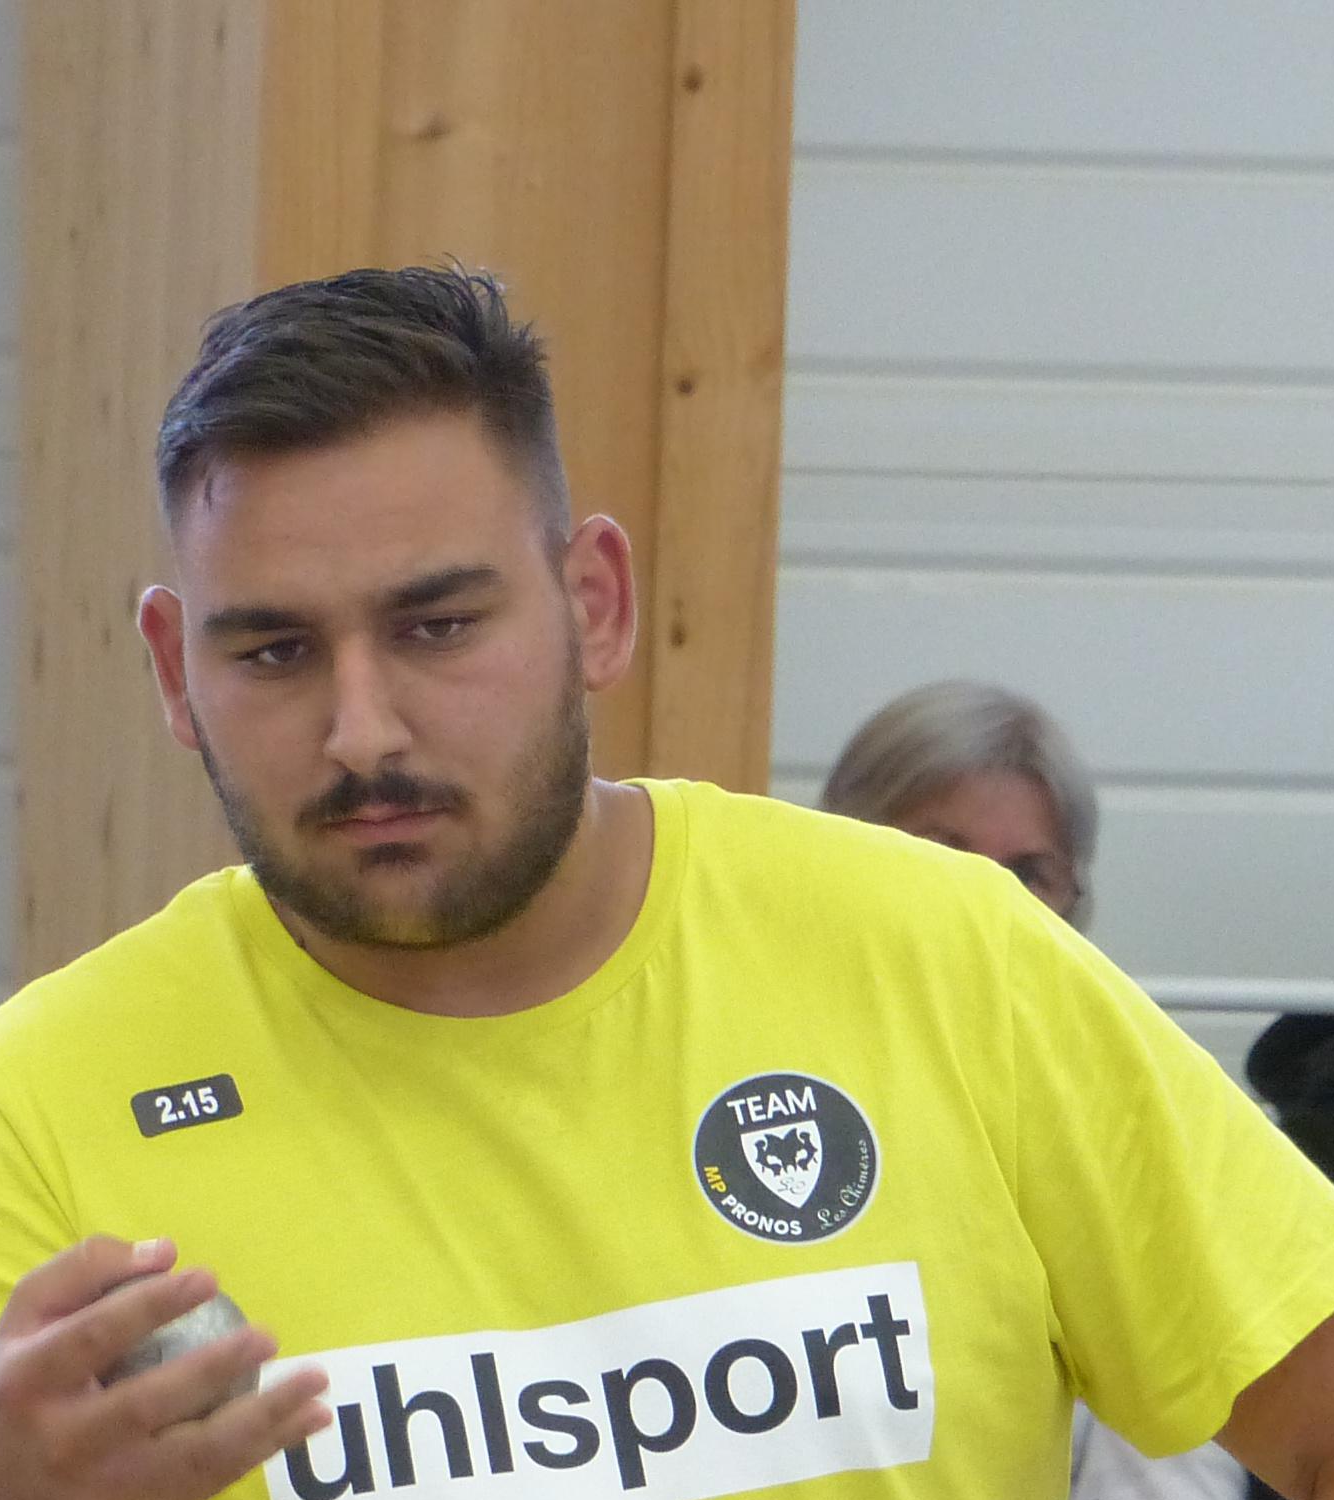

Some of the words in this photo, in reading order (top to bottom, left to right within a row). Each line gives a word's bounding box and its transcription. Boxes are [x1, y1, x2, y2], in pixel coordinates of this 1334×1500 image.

[155, 1086, 219, 1124] 2.15
[726, 1086, 817, 1126] TEAM
[704, 1166, 727, 1194] MP
[721, 1194, 803, 1236] PRONOS
